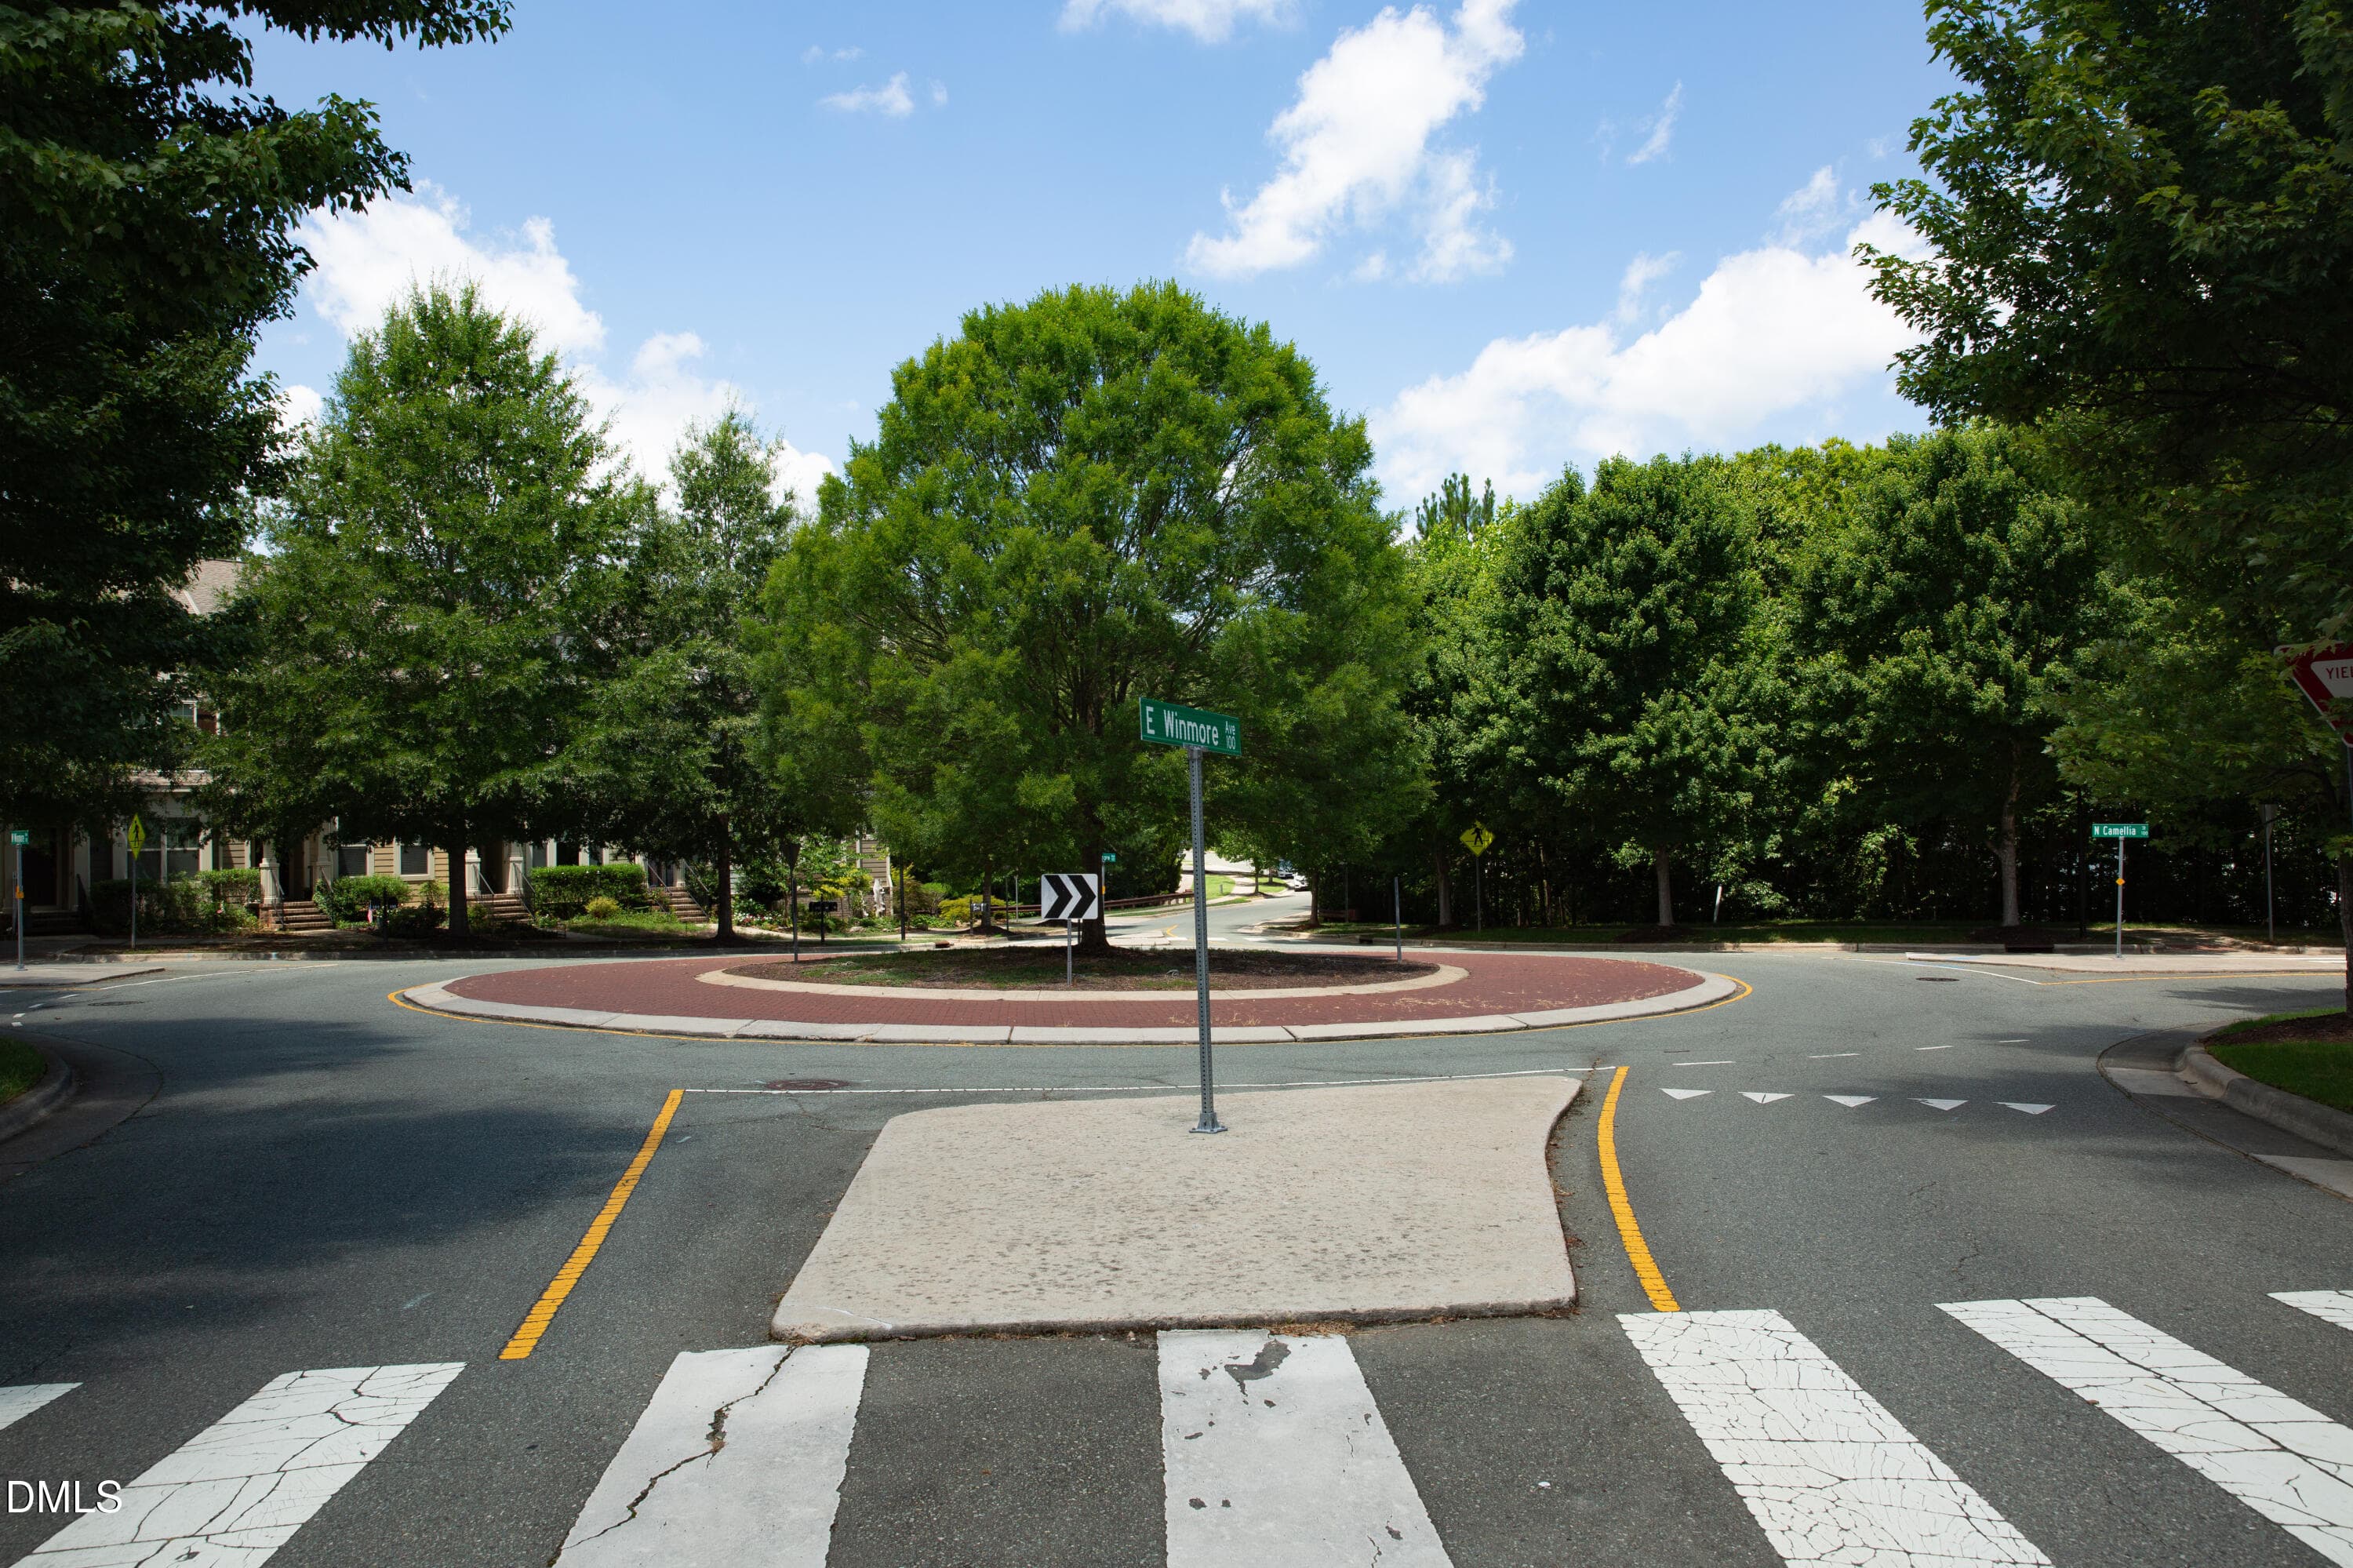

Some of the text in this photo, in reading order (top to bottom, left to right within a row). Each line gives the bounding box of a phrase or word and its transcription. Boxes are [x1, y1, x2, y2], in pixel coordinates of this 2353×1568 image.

[1146, 706, 1236, 746] E Winmore Ave
[1226, 736, 1236, 750] 100
[2094, 826, 2100, 835] N
[2103, 826, 2136, 835] Camellia
